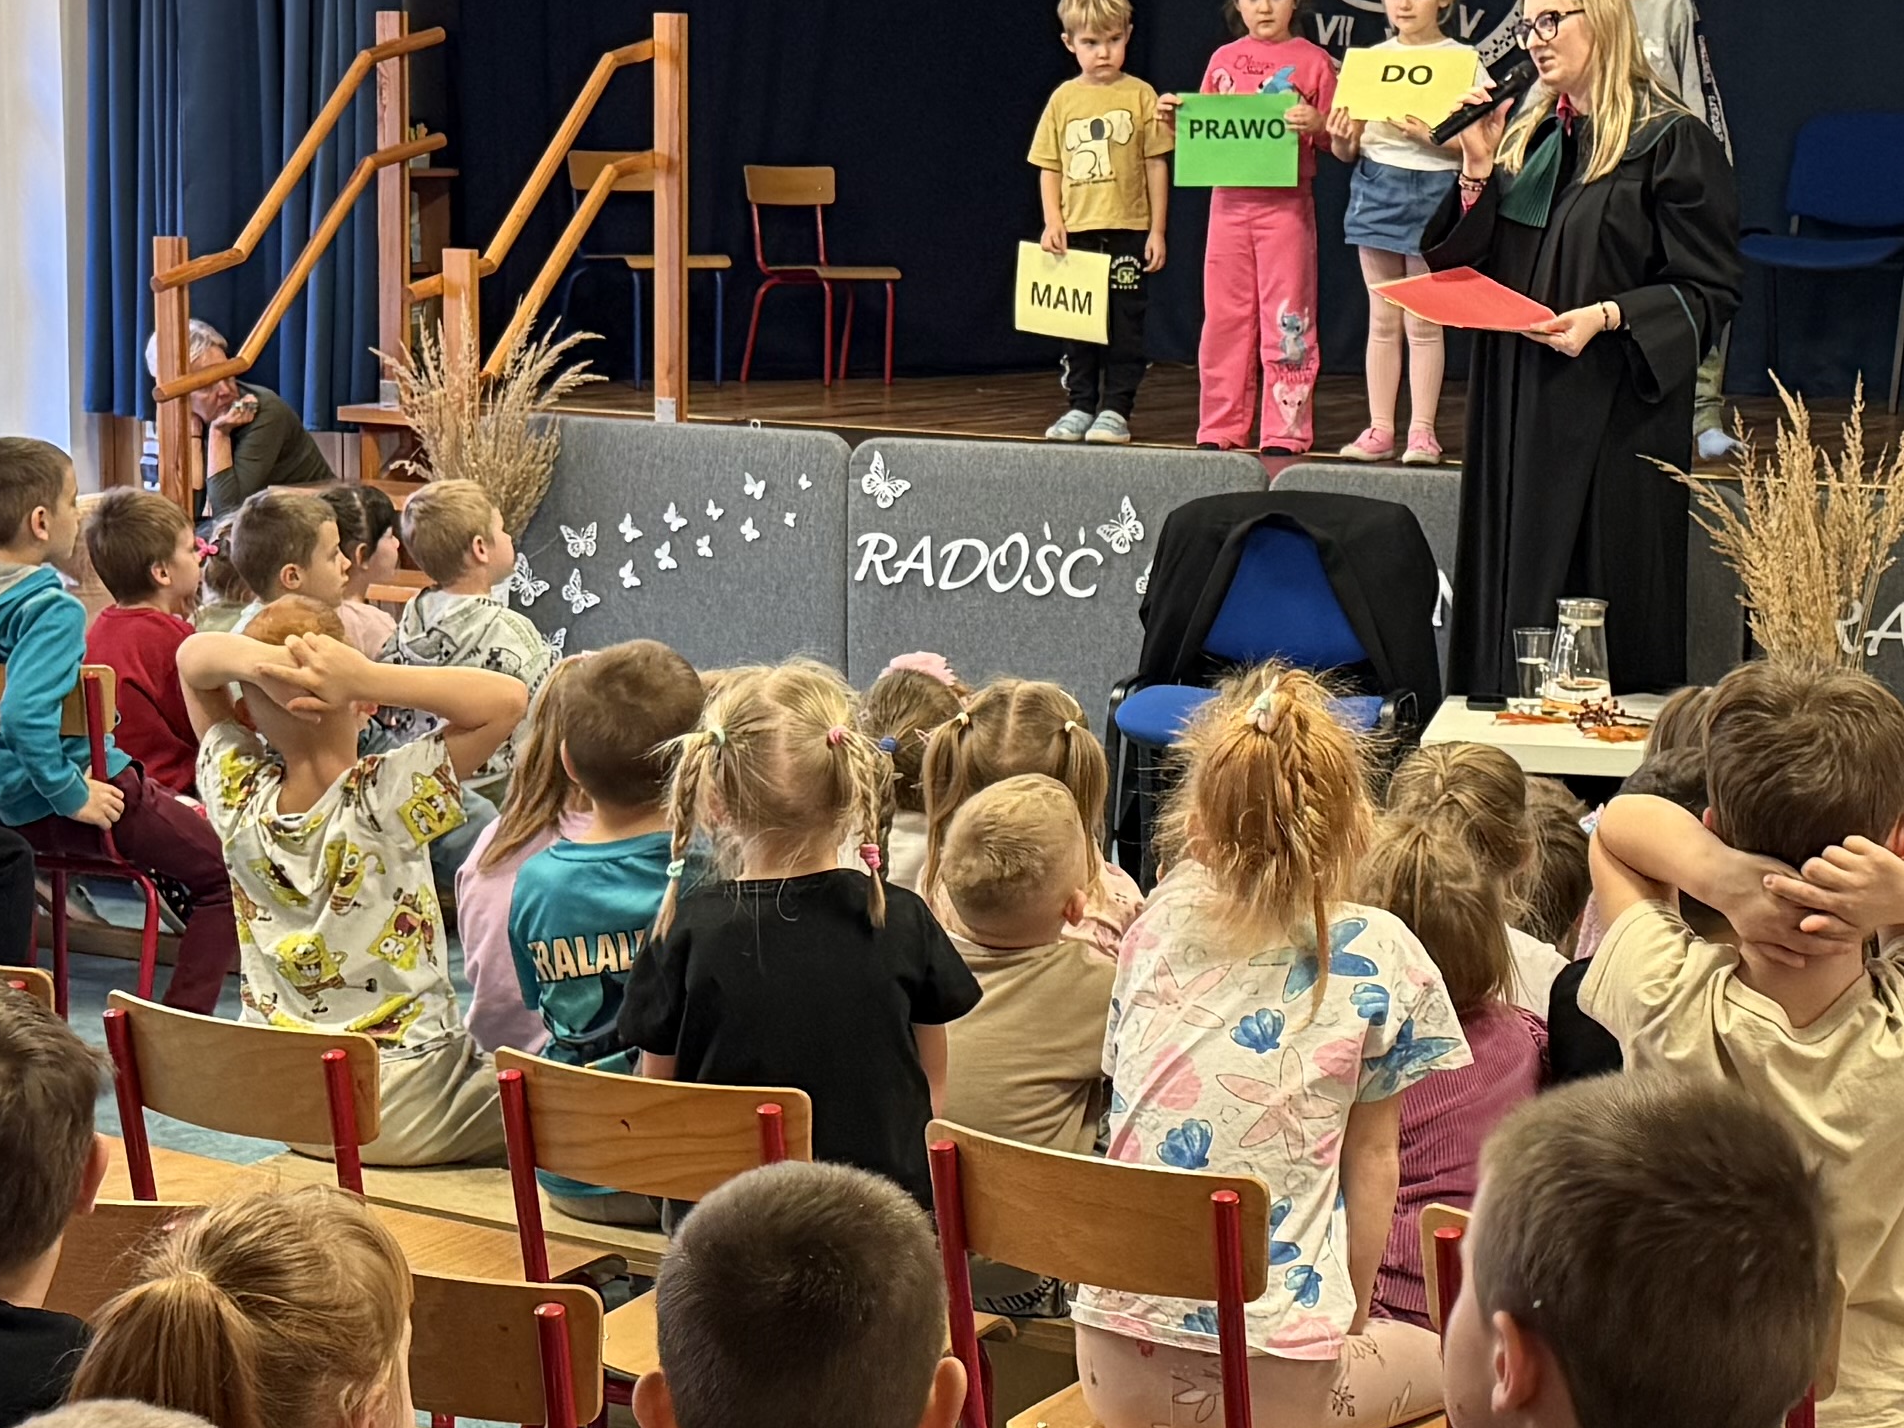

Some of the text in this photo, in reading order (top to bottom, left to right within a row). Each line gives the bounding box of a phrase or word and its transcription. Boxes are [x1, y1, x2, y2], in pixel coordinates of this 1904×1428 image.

[1315, 13, 1354, 46] VII
[1381, 65, 1433, 86] DO
[1189, 118, 1285, 140] PRAWO
[1031, 282, 1092, 316] MAM
[854, 521, 1104, 598] RADOŚĆ
